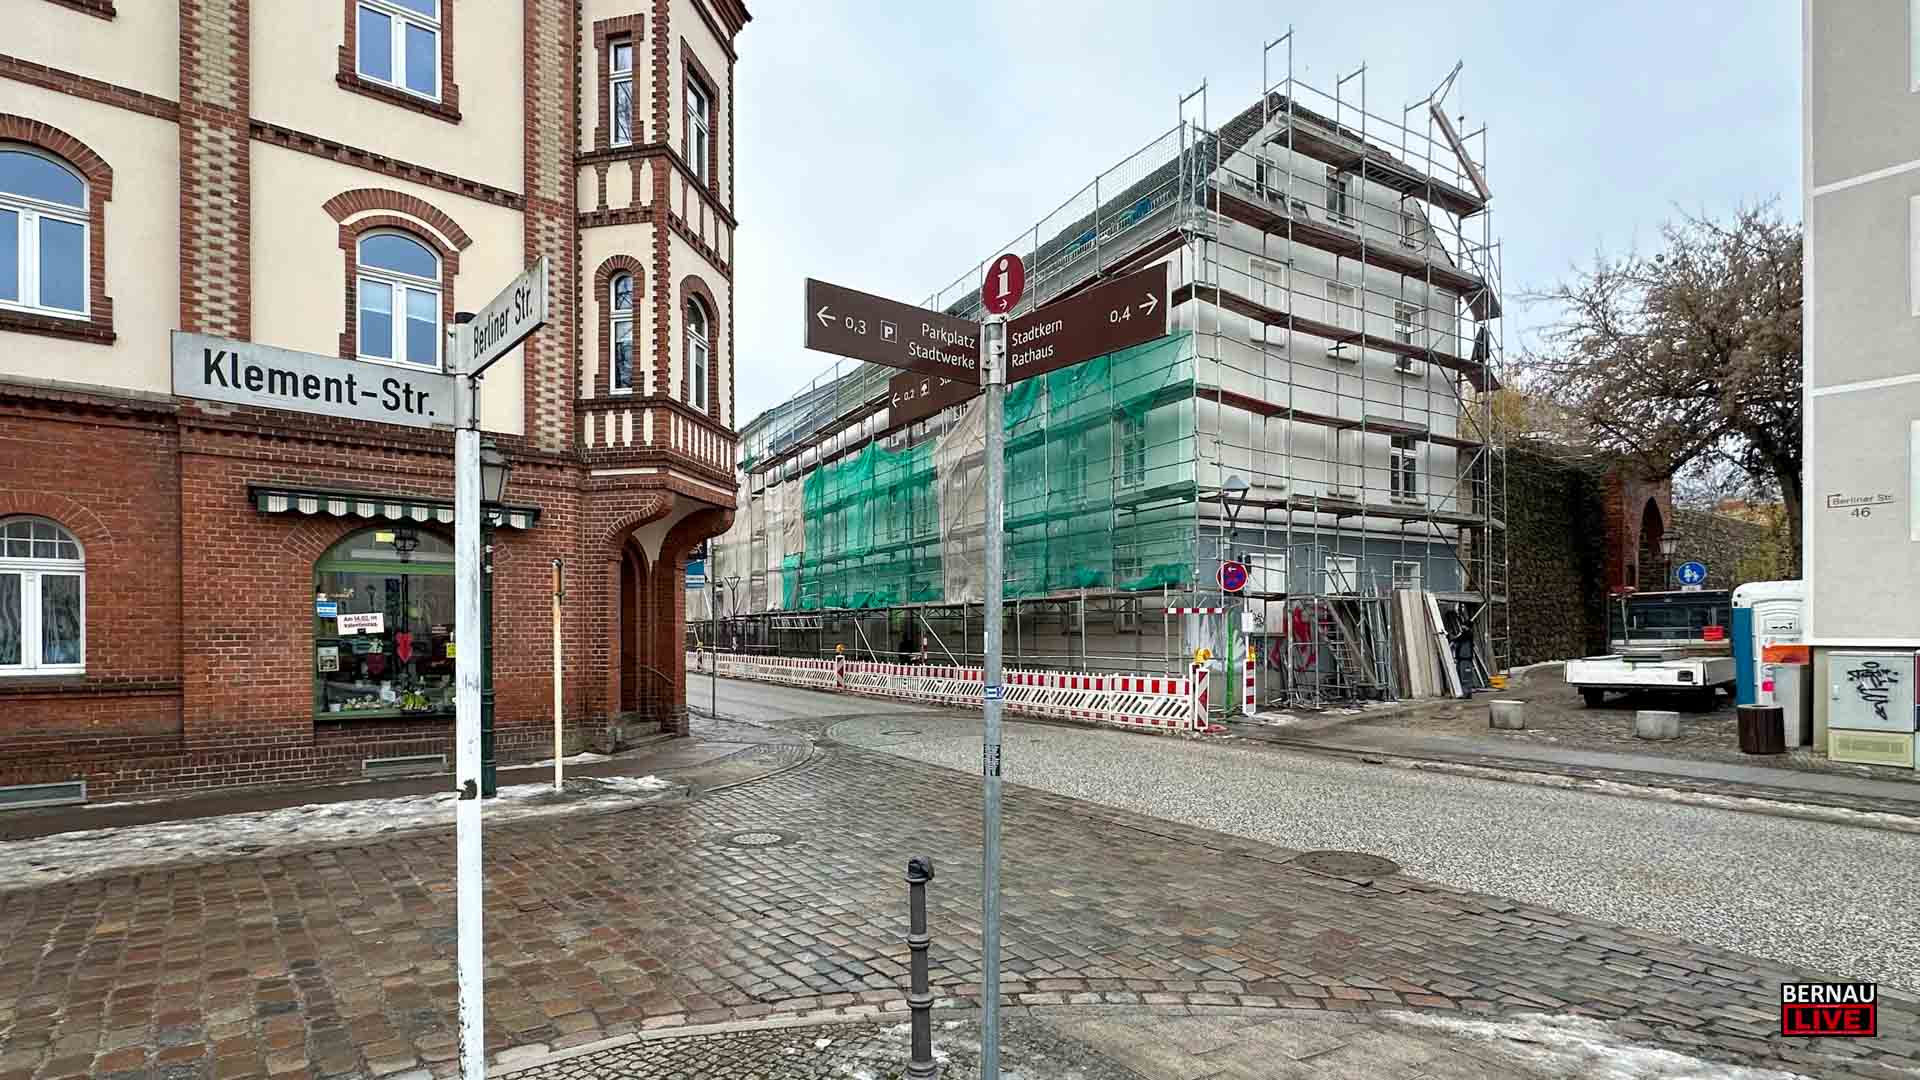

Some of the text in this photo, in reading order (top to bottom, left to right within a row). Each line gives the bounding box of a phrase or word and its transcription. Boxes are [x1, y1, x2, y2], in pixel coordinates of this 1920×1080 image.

[473, 279, 533, 359] Berliner Str.
[845, 316, 867, 335] 0,3
[1109, 308, 1131, 325] 0,4
[921, 323, 976, 350] Parkplatz
[1011, 318, 1063, 345] Stadtkern
[908, 343, 976, 370] Stadtwerke
[1011, 345, 1054, 368] Rathaus
[203, 348, 435, 417] Klement-Str.
[1832, 496, 1873, 505] Berliner
[1851, 507, 1871, 518] 46
